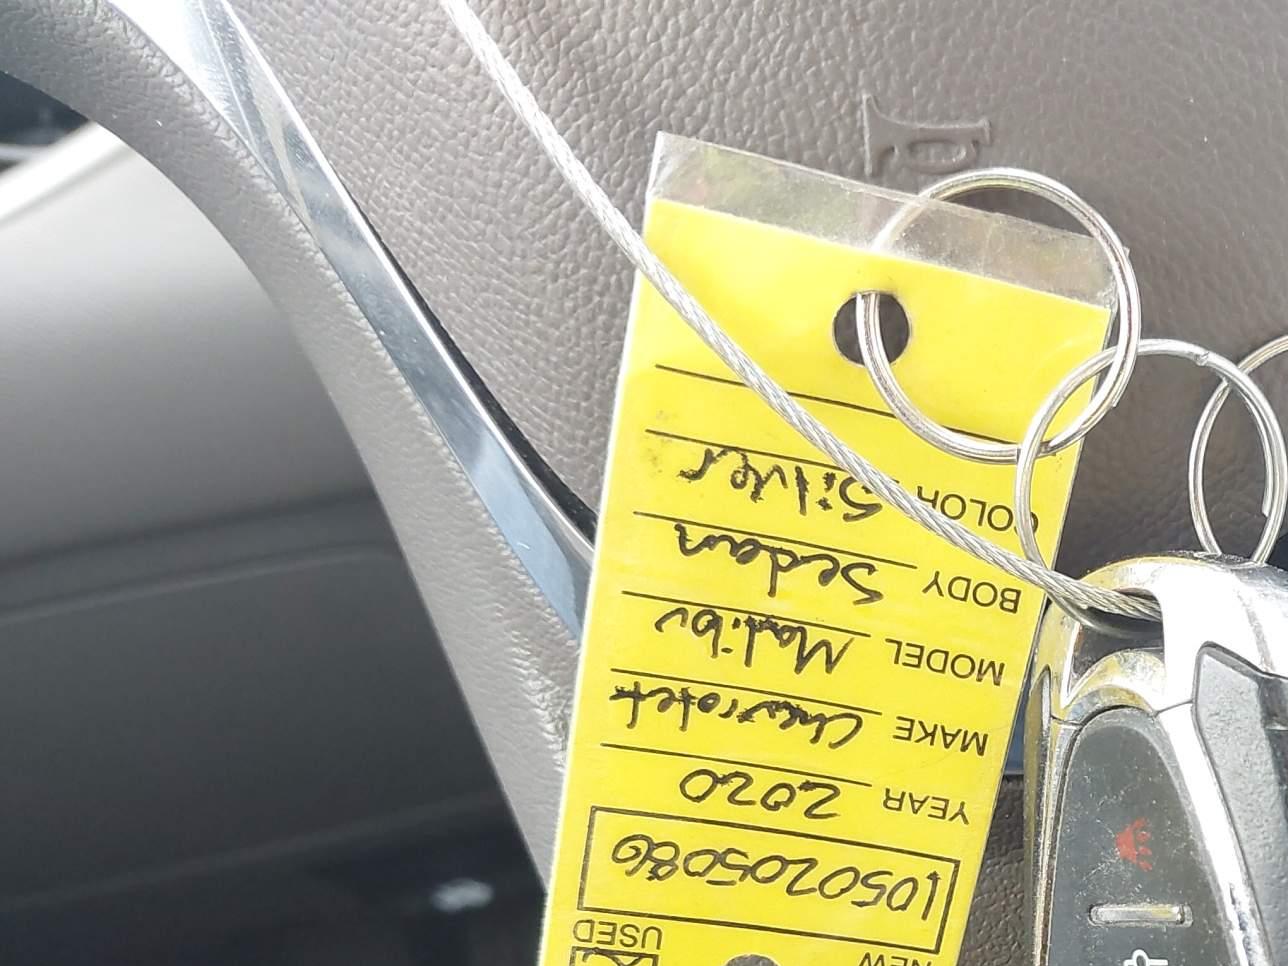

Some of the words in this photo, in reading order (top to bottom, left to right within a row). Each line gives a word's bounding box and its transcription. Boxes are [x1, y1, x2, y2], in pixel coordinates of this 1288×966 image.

[677, 448, 883, 522] Silver
[674, 522, 884, 606] Sedan
[922, 570, 1022, 614] BODY
[885, 637, 1006, 687] MODEL
[893, 716, 989, 756] MAKE
[679, 768, 841, 819] 2020
[882, 787, 970, 826] YEAR
[572, 918, 664, 951] USED
